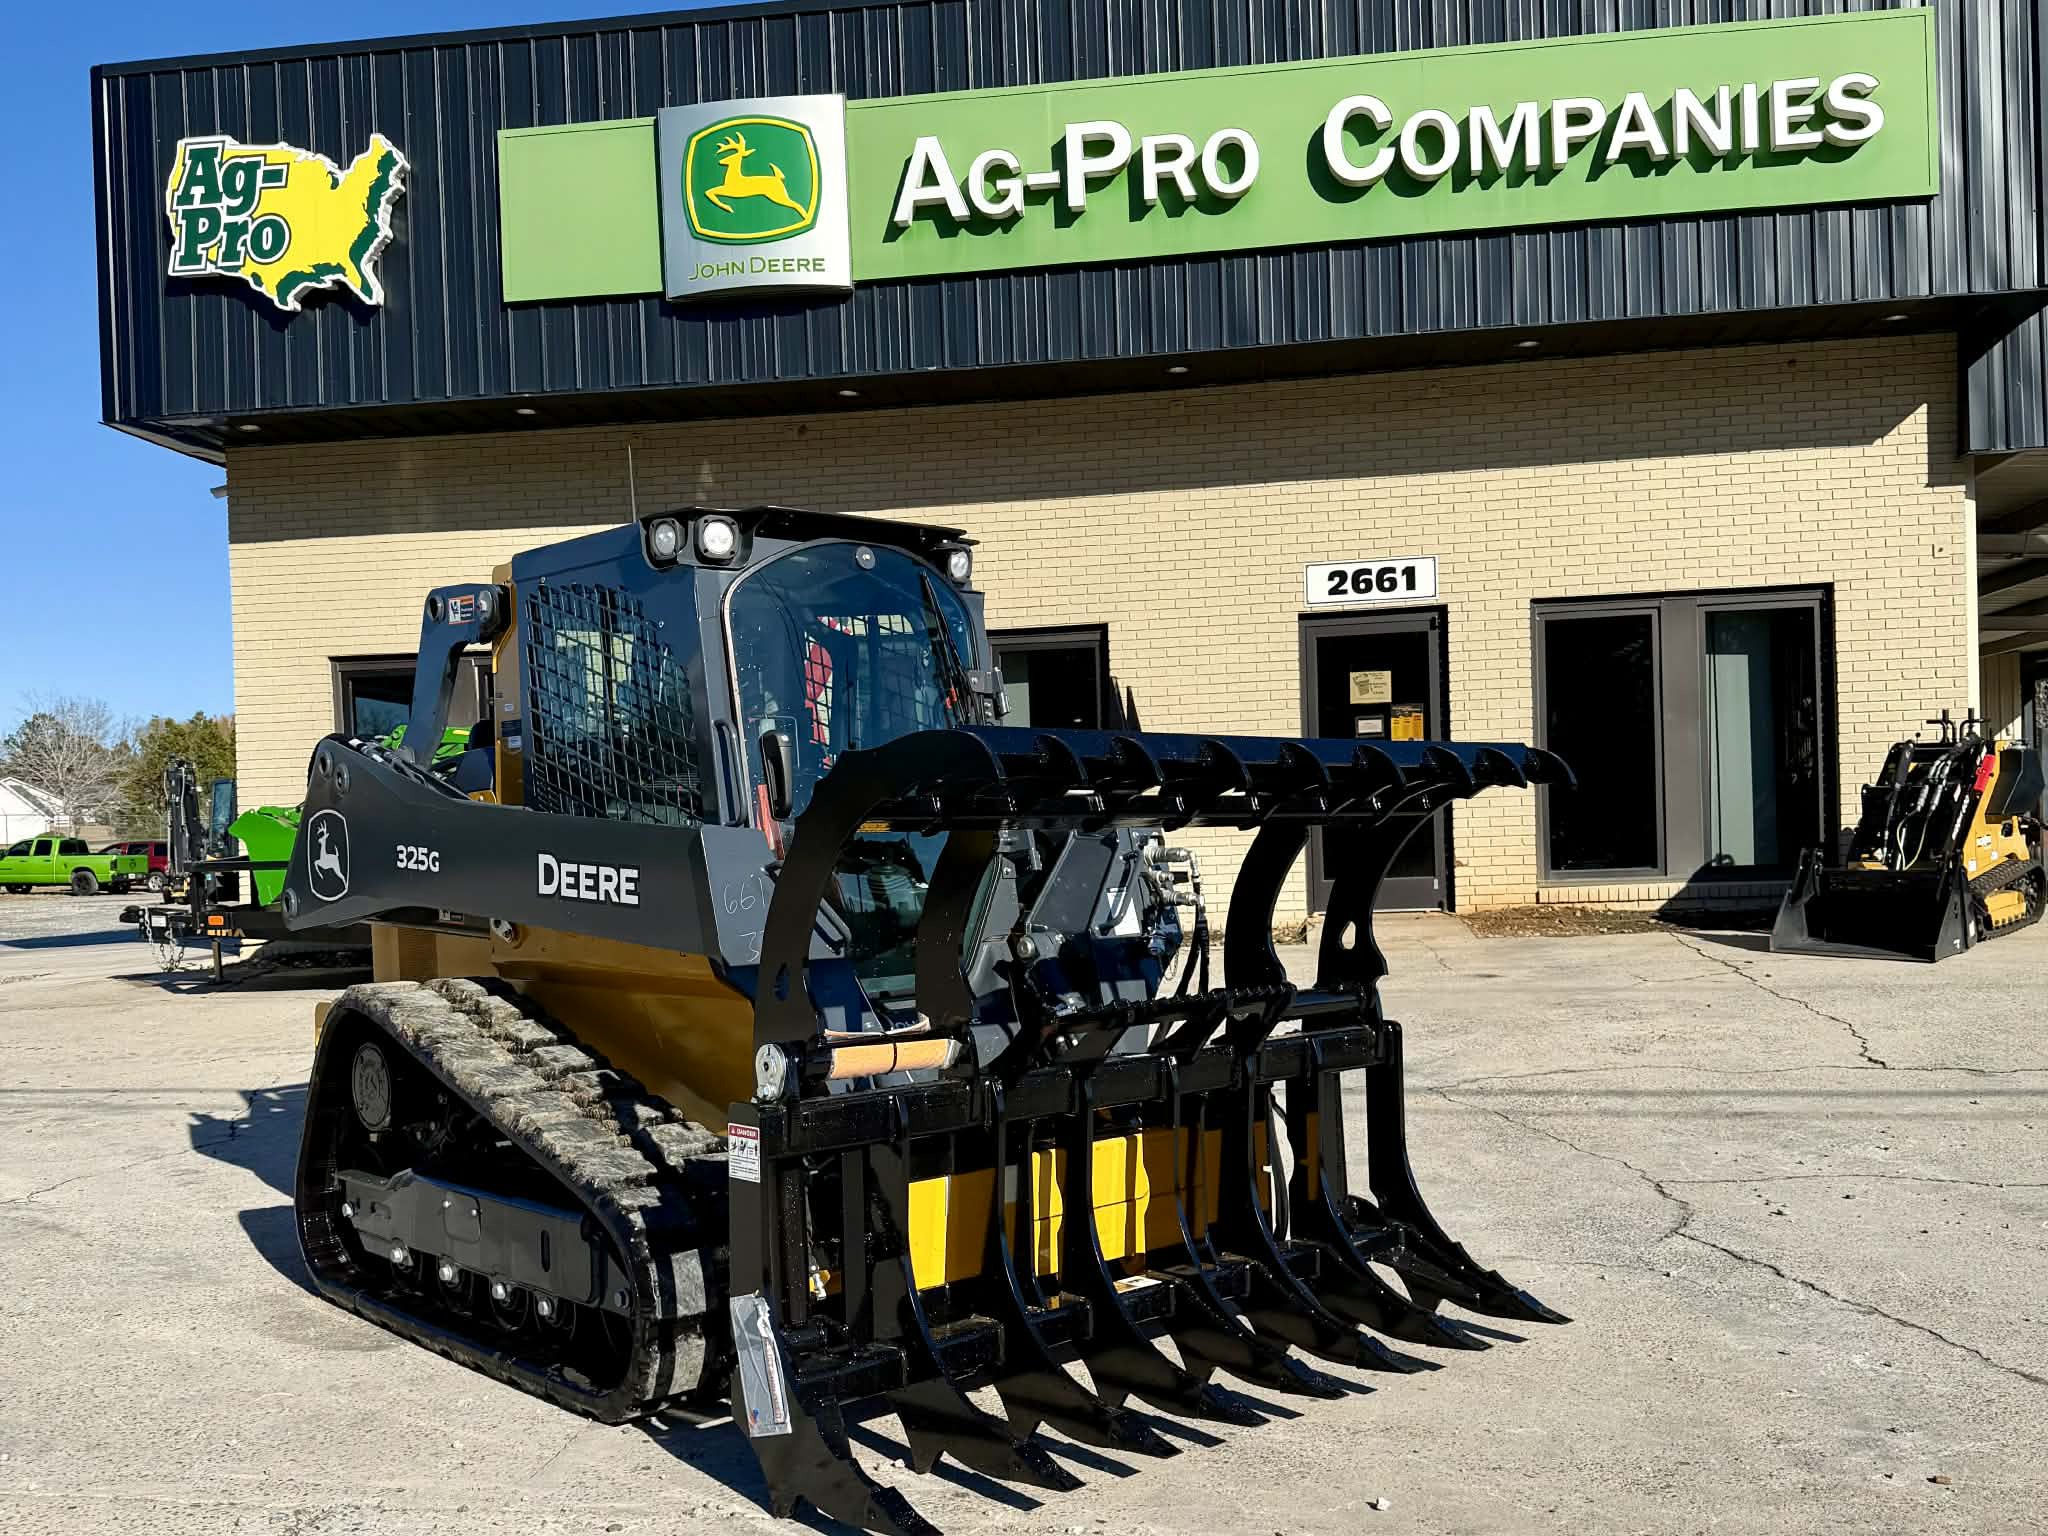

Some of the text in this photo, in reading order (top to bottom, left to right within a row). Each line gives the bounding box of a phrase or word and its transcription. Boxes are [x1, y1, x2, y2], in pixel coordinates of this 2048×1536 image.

[174, 143, 288, 216] Ag-
[177, 207, 288, 268] Pro
[1327, 565, 1417, 596] 2661
[395, 844, 640, 906] 325G DEERE
